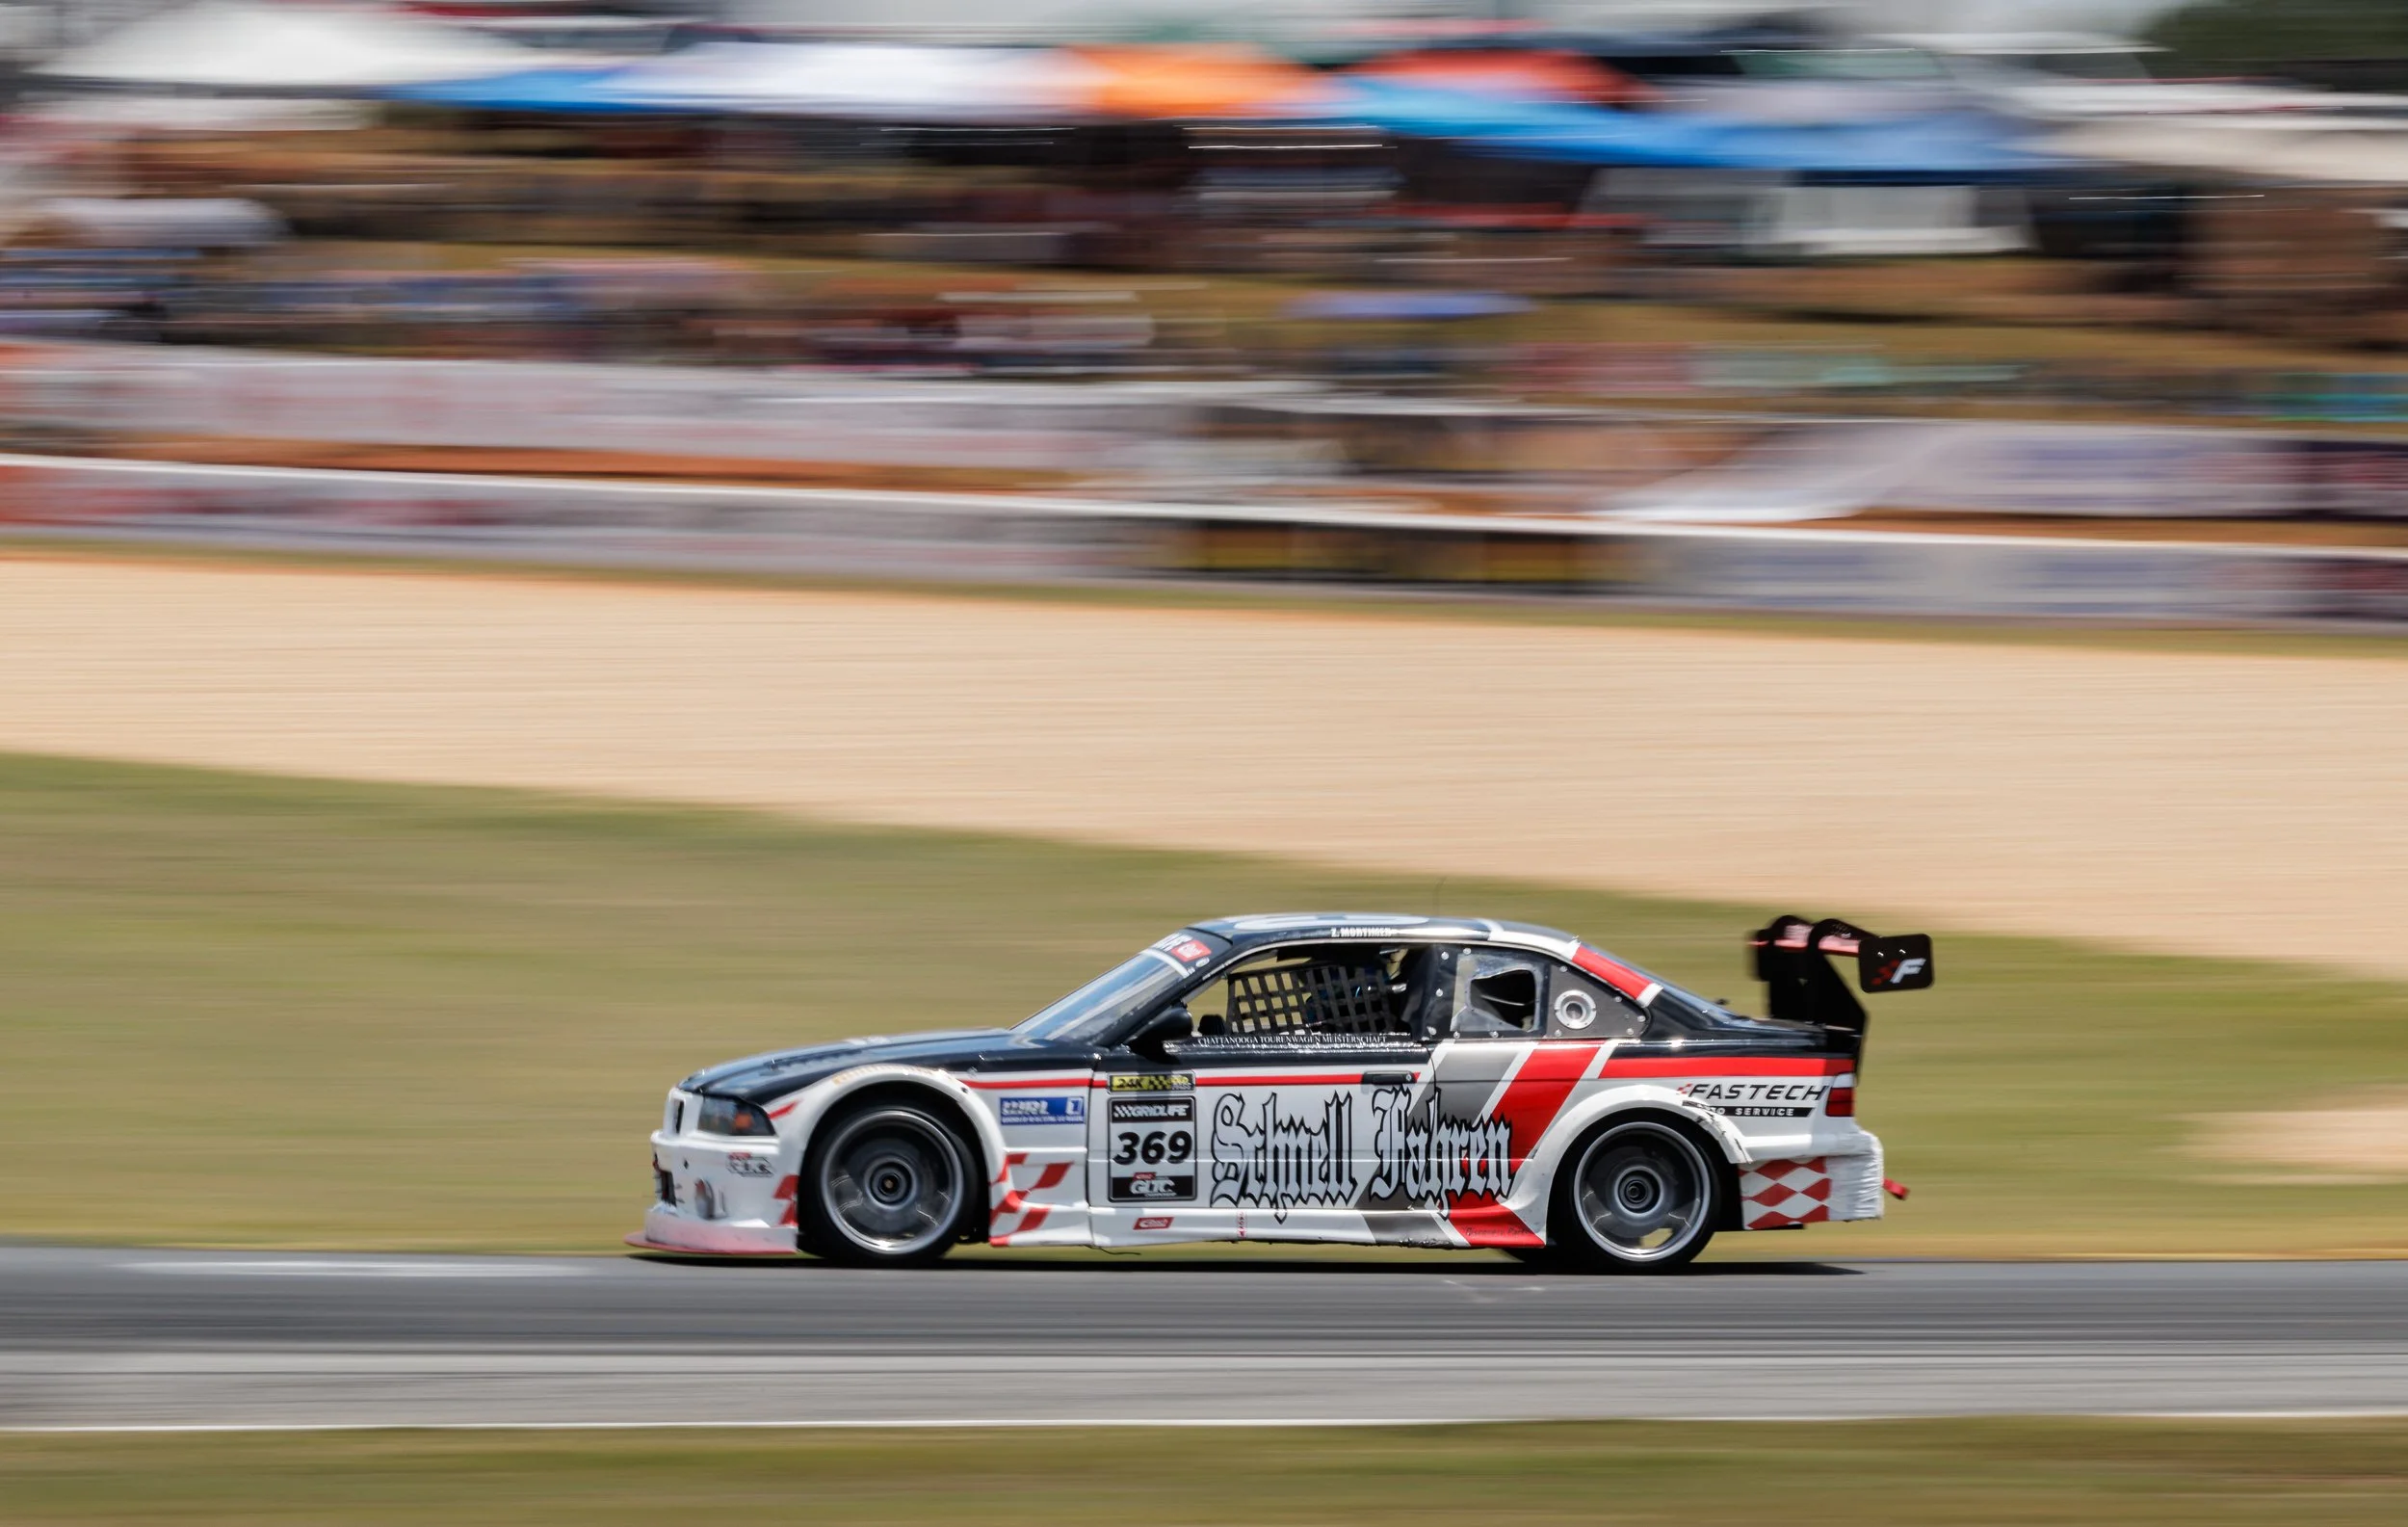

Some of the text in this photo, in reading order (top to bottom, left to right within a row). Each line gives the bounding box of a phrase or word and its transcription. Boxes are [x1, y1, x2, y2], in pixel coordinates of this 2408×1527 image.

[1688, 1084, 1829, 1100] FASTECH
[1132, 1104, 1190, 1118] GRIDLIFE
[1112, 1130, 1192, 1165] 369
[1210, 1086, 1513, 1224] Schnell Fahren
